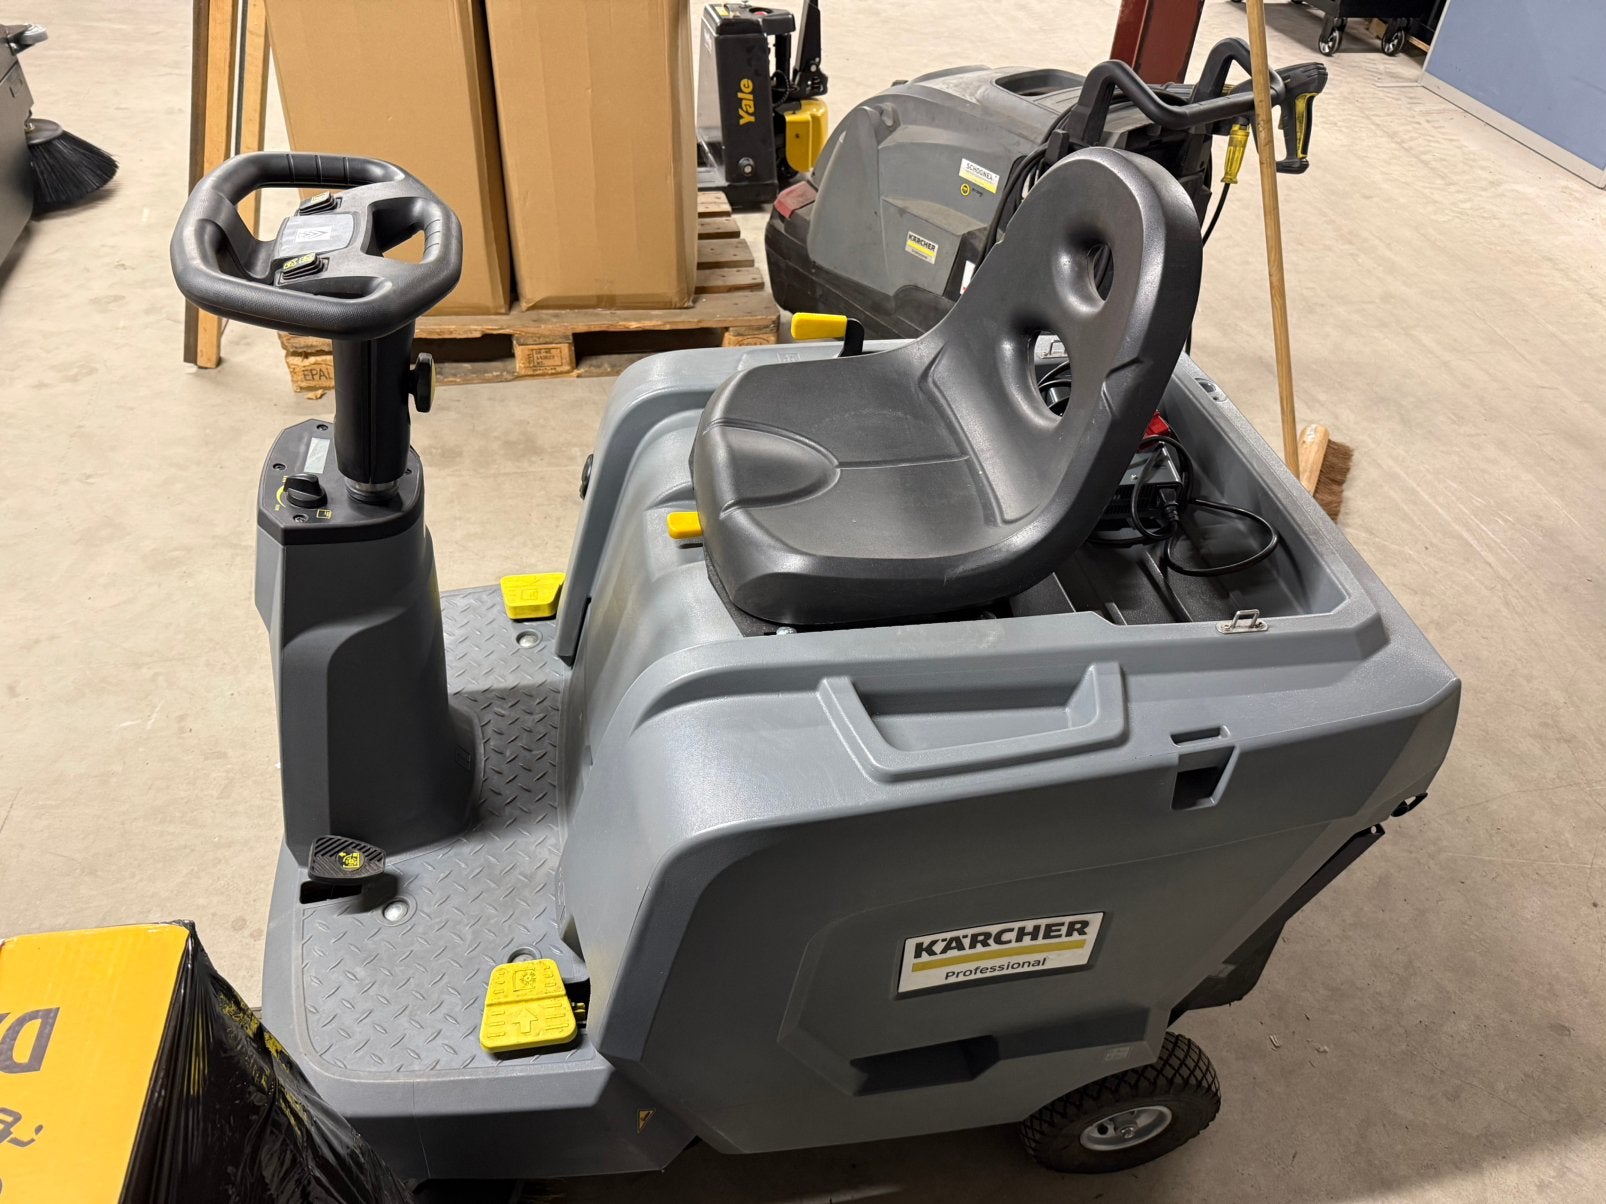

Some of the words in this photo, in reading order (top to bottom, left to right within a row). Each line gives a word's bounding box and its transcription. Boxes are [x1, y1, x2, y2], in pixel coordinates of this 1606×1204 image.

[737, 78, 755, 125] Yale
[302, 367, 333, 382] EPAL
[913, 919, 1090, 959] KÄRCHER
[944, 957, 1047, 981] Professional
